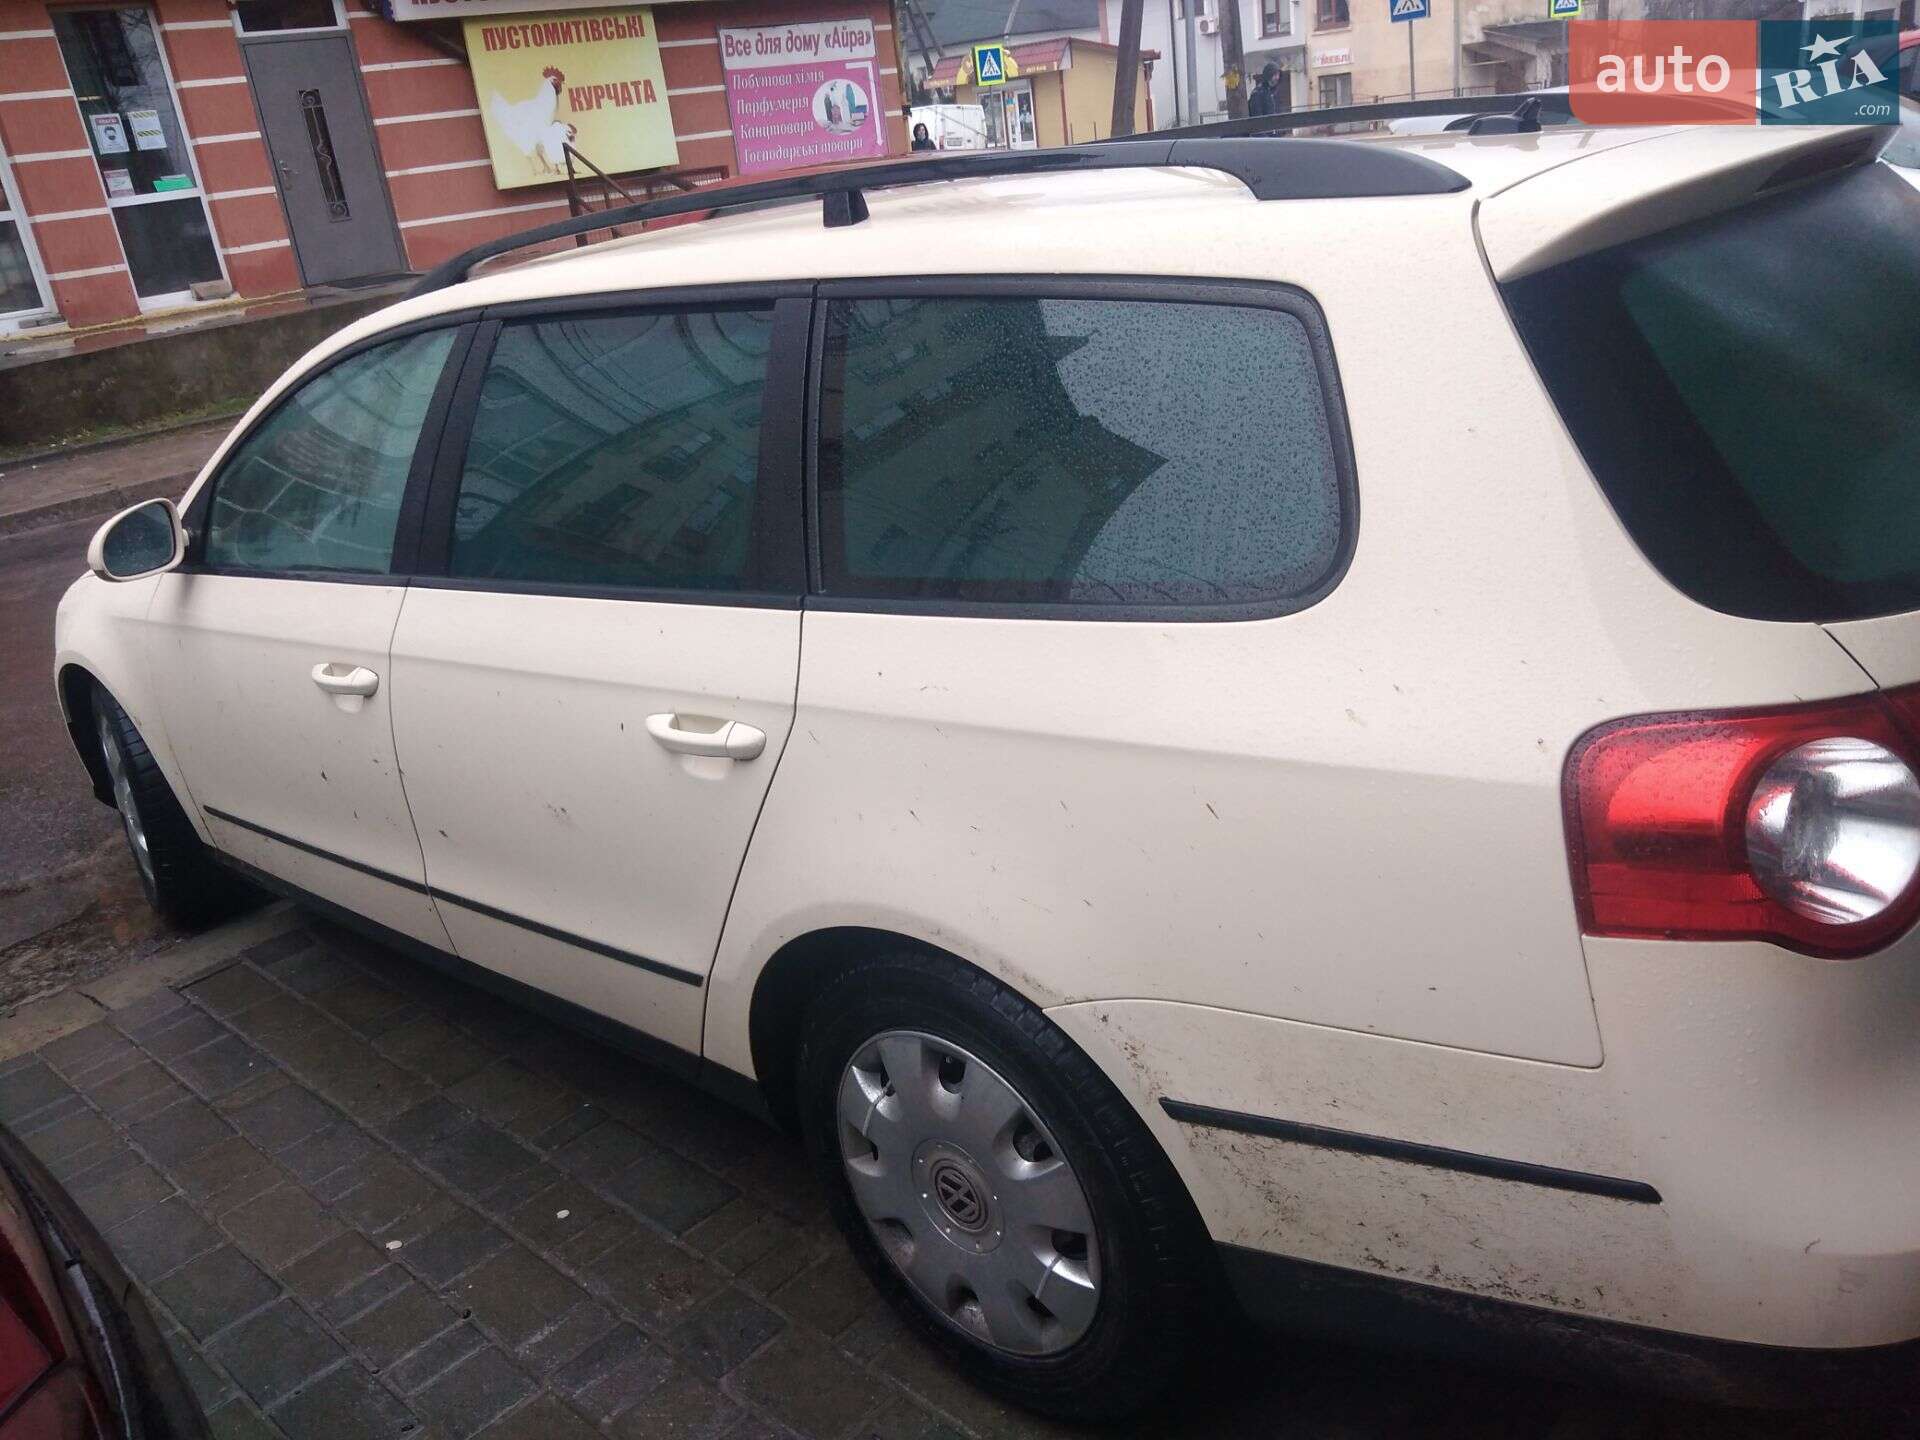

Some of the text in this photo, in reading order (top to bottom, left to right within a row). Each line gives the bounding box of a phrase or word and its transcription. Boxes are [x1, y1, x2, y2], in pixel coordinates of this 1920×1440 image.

[482, 15, 645, 51] ПУСТОМИТІВСЬКІ
[724, 26, 871, 57] Все для дому «Айра»
[733, 68, 825, 91] Побутова хімія
[568, 79, 657, 112] КУРЧАТА
[737, 97, 809, 117] Парфумерія
[741, 121, 814, 139] Канцтовари
[745, 138, 863, 164] Господарські товари
